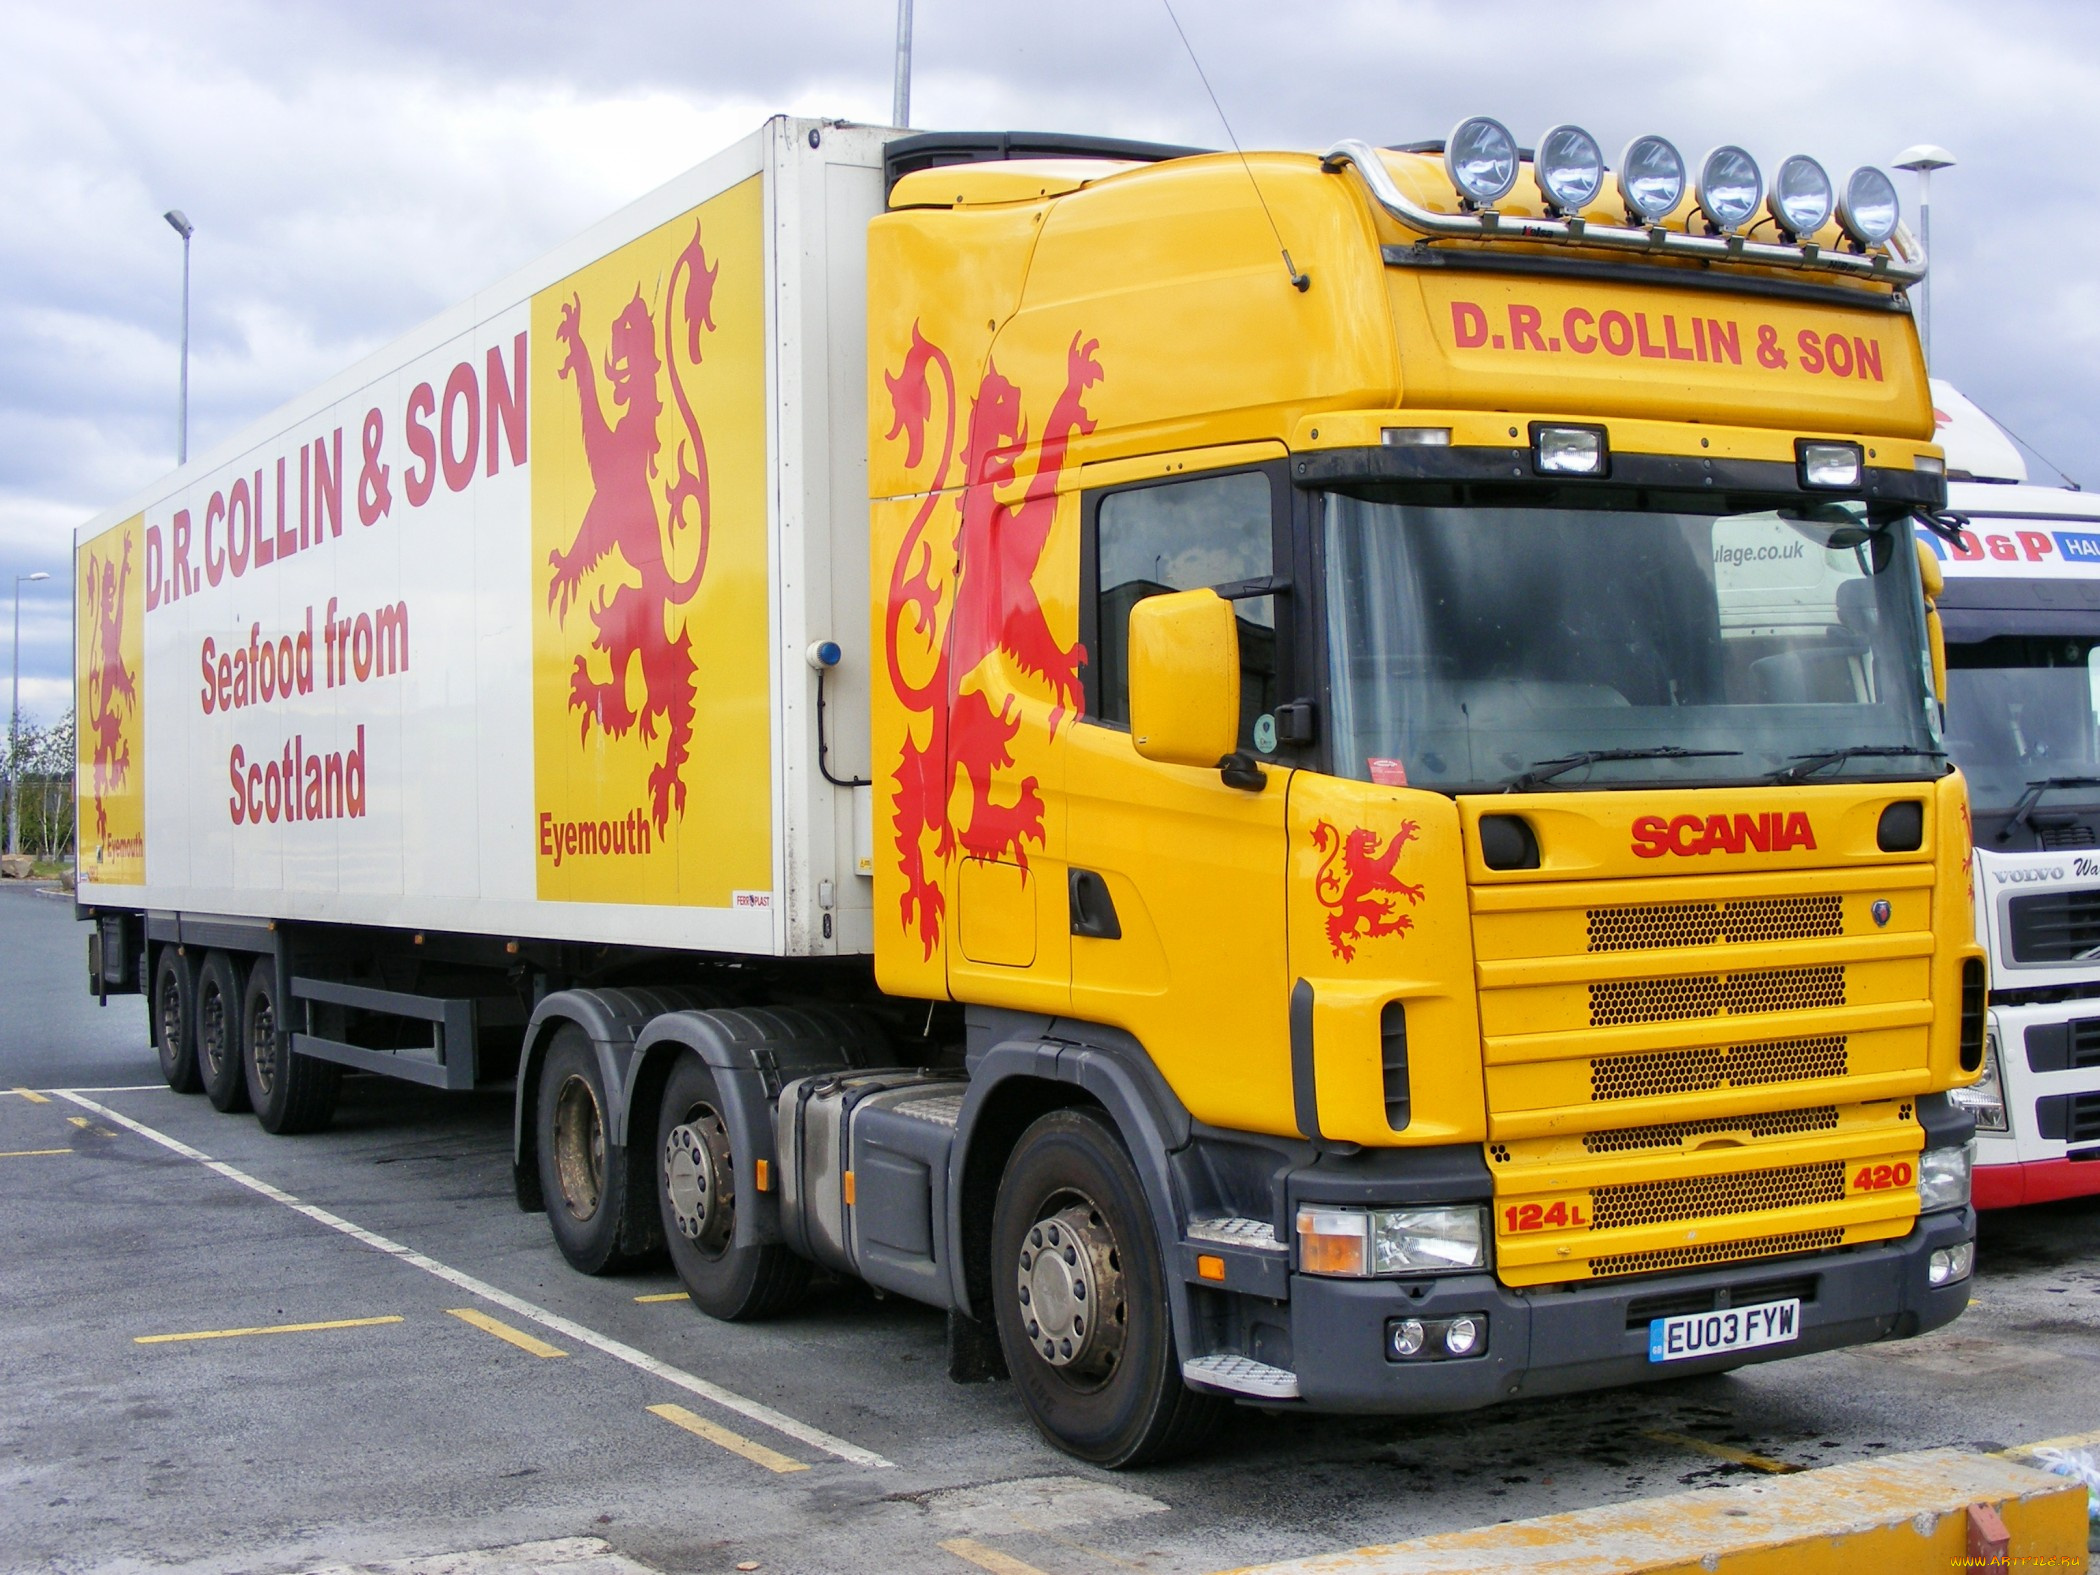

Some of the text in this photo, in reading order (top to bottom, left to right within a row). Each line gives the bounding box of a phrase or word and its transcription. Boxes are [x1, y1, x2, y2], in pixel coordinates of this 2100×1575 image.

[1450, 301, 1884, 382] D.R.COLLIN & SON
[145, 331, 528, 612] D.R.COLLIN & SON
[201, 597, 409, 715] Seafood from
[229, 724, 366, 825] Scotland
[107, 832, 143, 864] Eyemouth
[540, 808, 651, 867] Eyemouth
[1631, 811, 1817, 858] SCANIA
[1992, 867, 2064, 883] VOLVO
[2074, 858, 2100, 877] Wa
[1853, 1163, 1912, 1190] 420
[1668, 1304, 1794, 1353] EU03 FYW
